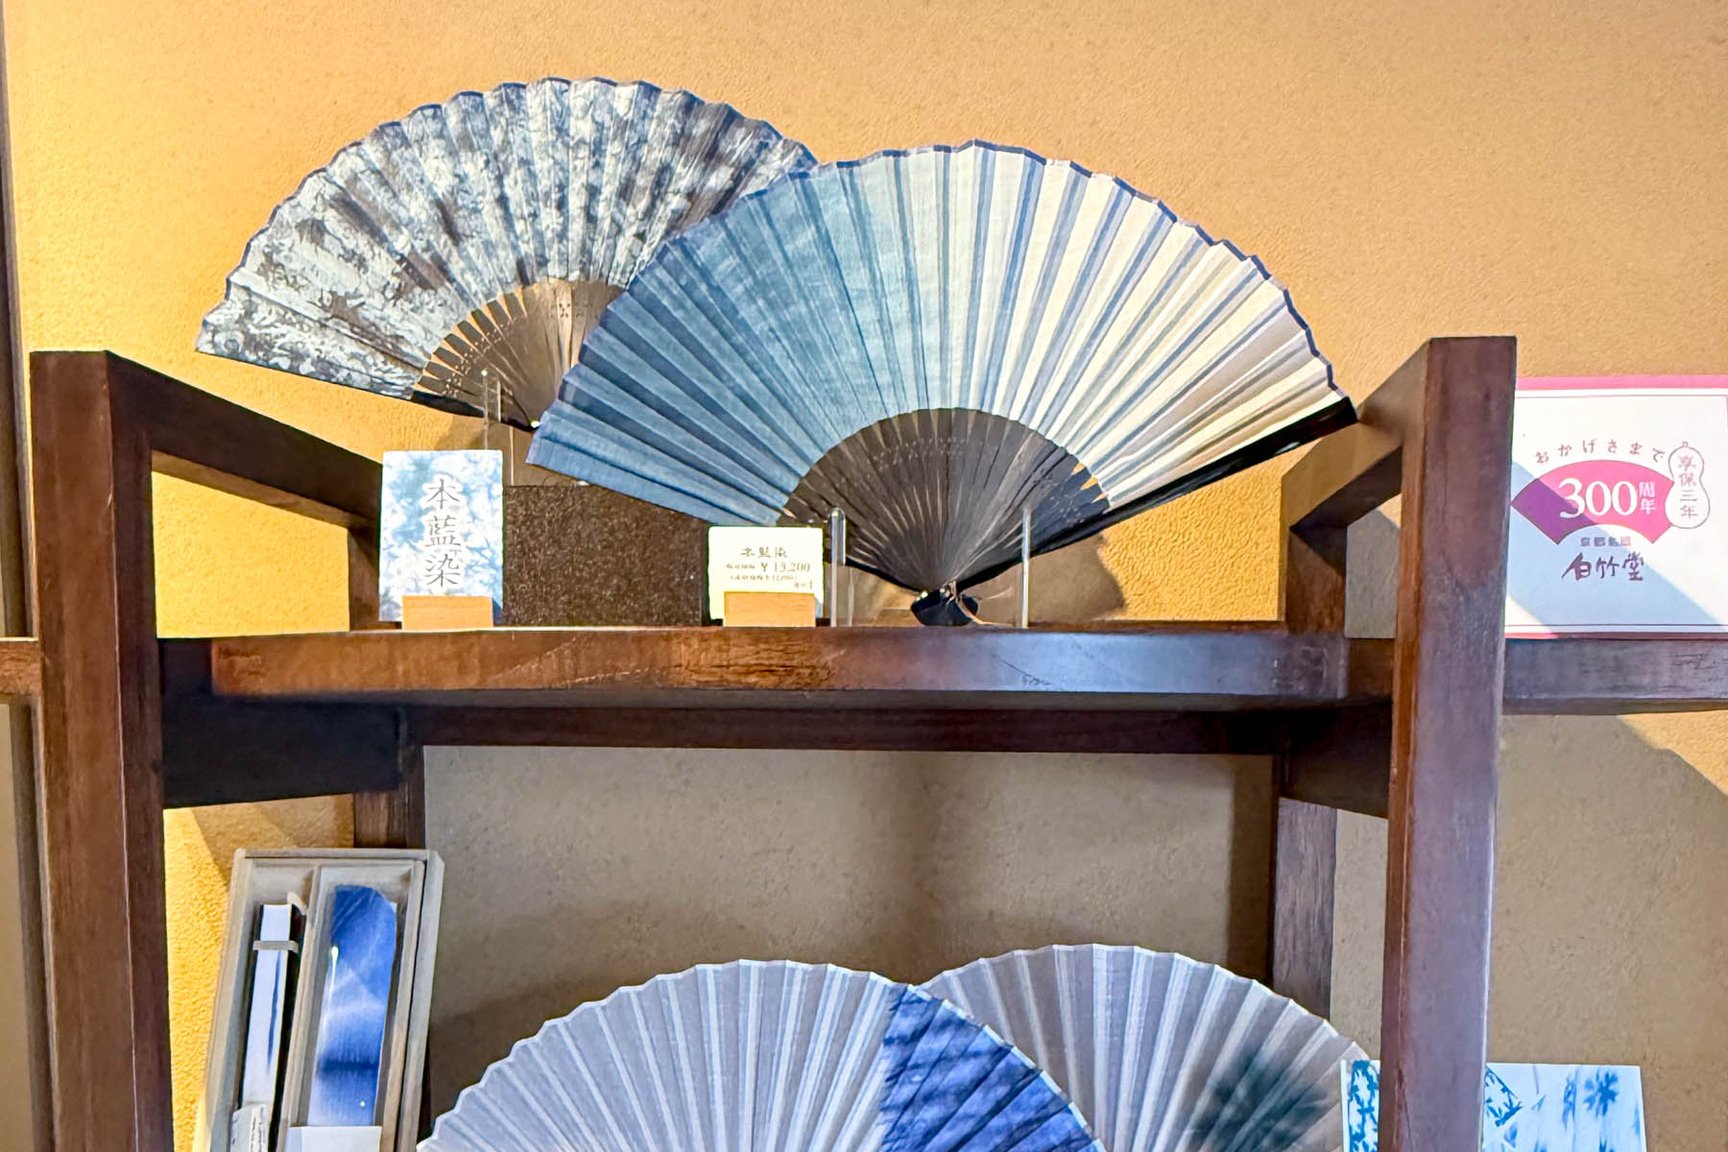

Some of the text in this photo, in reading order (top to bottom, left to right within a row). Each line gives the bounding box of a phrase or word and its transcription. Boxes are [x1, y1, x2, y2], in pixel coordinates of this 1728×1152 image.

[1535, 438, 1665, 466] おかげさまで
[1558, 478, 1657, 518] 300 周年
[1677, 455, 1699, 519] 享保三年
[424, 478, 462, 588] 本藍染
